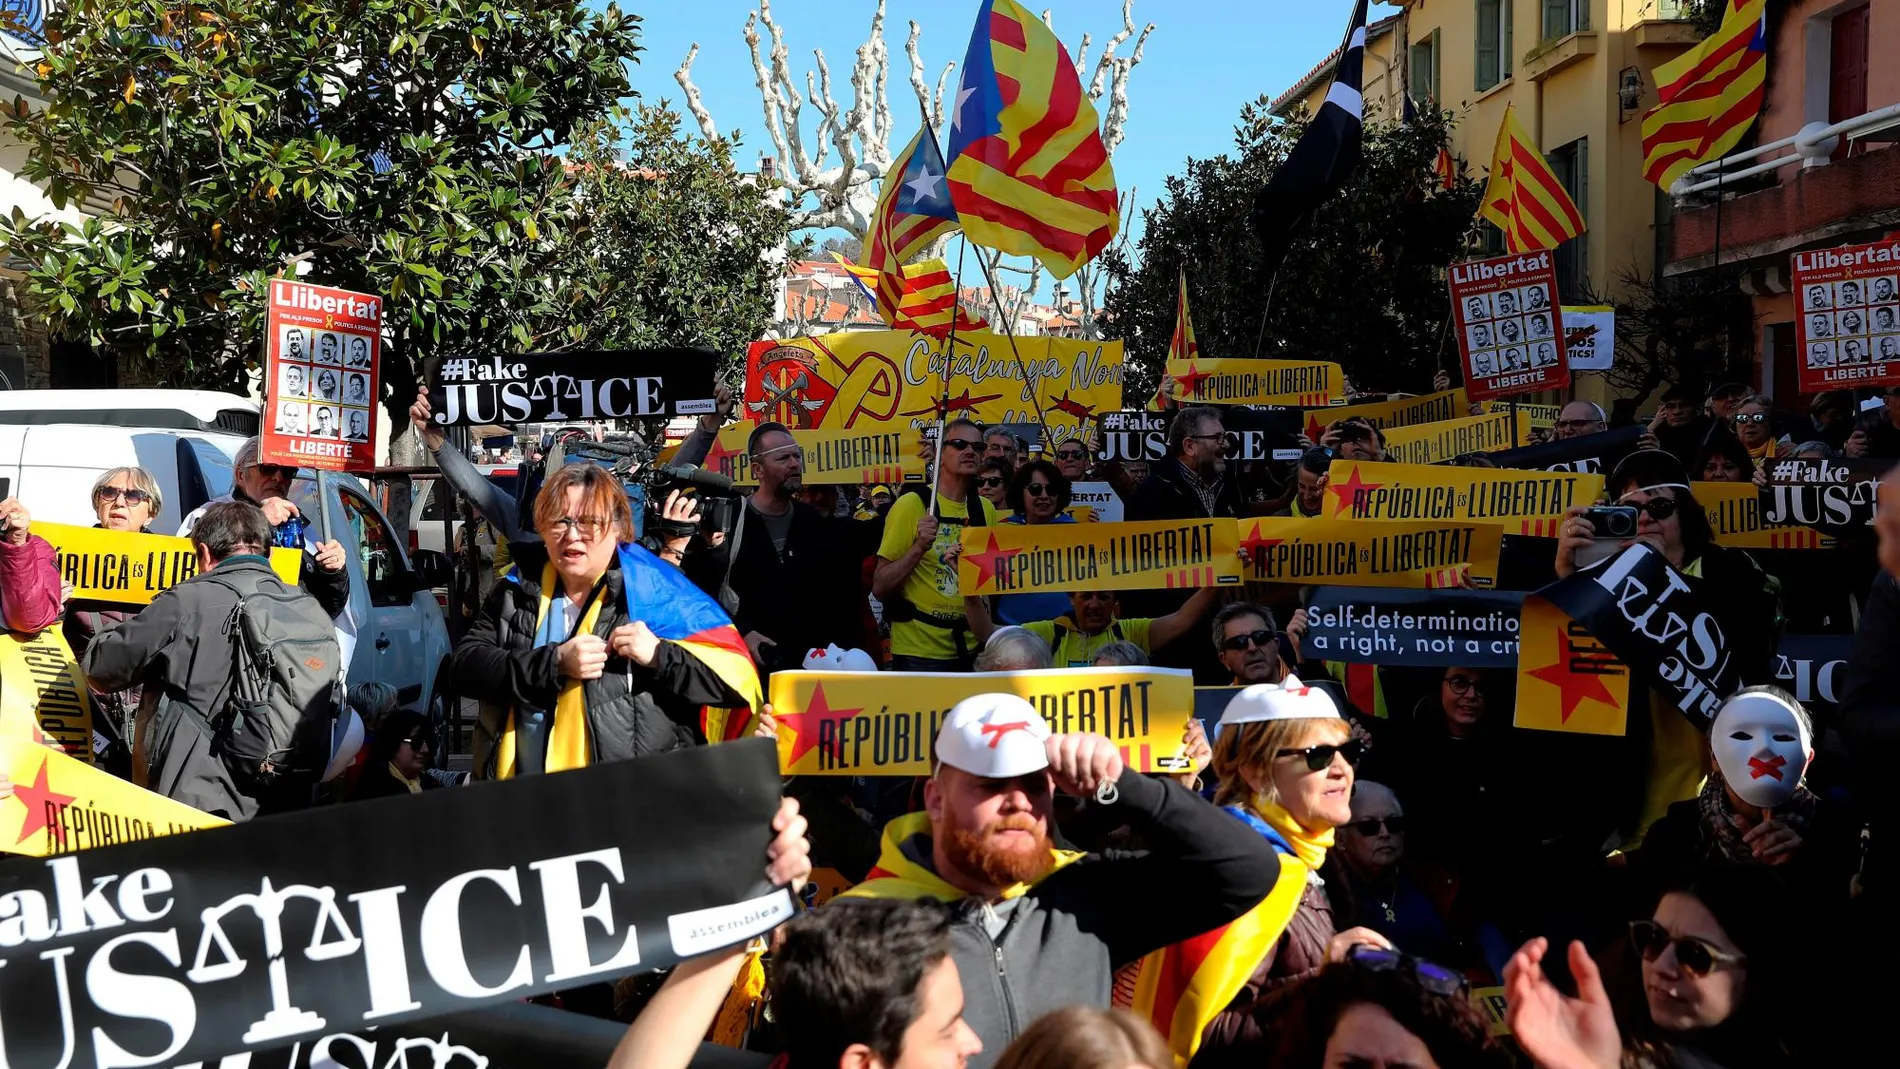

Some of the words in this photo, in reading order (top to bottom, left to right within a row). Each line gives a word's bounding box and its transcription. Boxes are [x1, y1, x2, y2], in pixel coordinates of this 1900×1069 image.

[1452, 252, 1550, 285] Llibertat
[1796, 242, 1900, 272] Llibertat
[276, 284, 377, 320] Llibertat
[441, 357, 528, 381] #Fake
[904, 338, 1066, 402] Catalunya
[1568, 350, 1595, 358] TICS!
[1194, 372, 1258, 401] REPÚBLICA
[1266, 365, 1329, 396] LLIBERTAT
[1488, 370, 1546, 390] LIBERTÉ
[1824, 364, 1887, 381] LIBERTÉ
[1103, 412, 1166, 431] #Fake
[1438, 414, 1510, 460] LLIBERTAT
[290, 440, 353, 458] LIBERTÉ
[816, 433, 902, 472] LLIBERTAT
[1772, 459, 1850, 483] #Fake
[1072, 492, 1112, 502] ERTAT
[1352, 482, 1454, 518] REPÚBLICA
[1467, 478, 1577, 518] LLIBERTAT
[995, 544, 1098, 591] REPÚBLICA
[1110, 523, 1213, 576] LLIBERTAT
[1254, 537, 1357, 579] REPÚBLICA
[1371, 528, 1475, 574] LLIBERTAT
[133, 561, 144, 578] ÉS
[145, 551, 197, 591] LLIB
[1307, 605, 1519, 632] Self-determinatio
[1313, 634, 1328, 650] a
[1339, 630, 1403, 656] right,
[1416, 635, 1455, 654] not
[1464, 640, 1480, 655] a
[1490, 636, 1519, 656] cri
[0, 856, 175, 947] ake
[689, 904, 780, 939] assemblea
[0, 847, 640, 1069] USTICE
